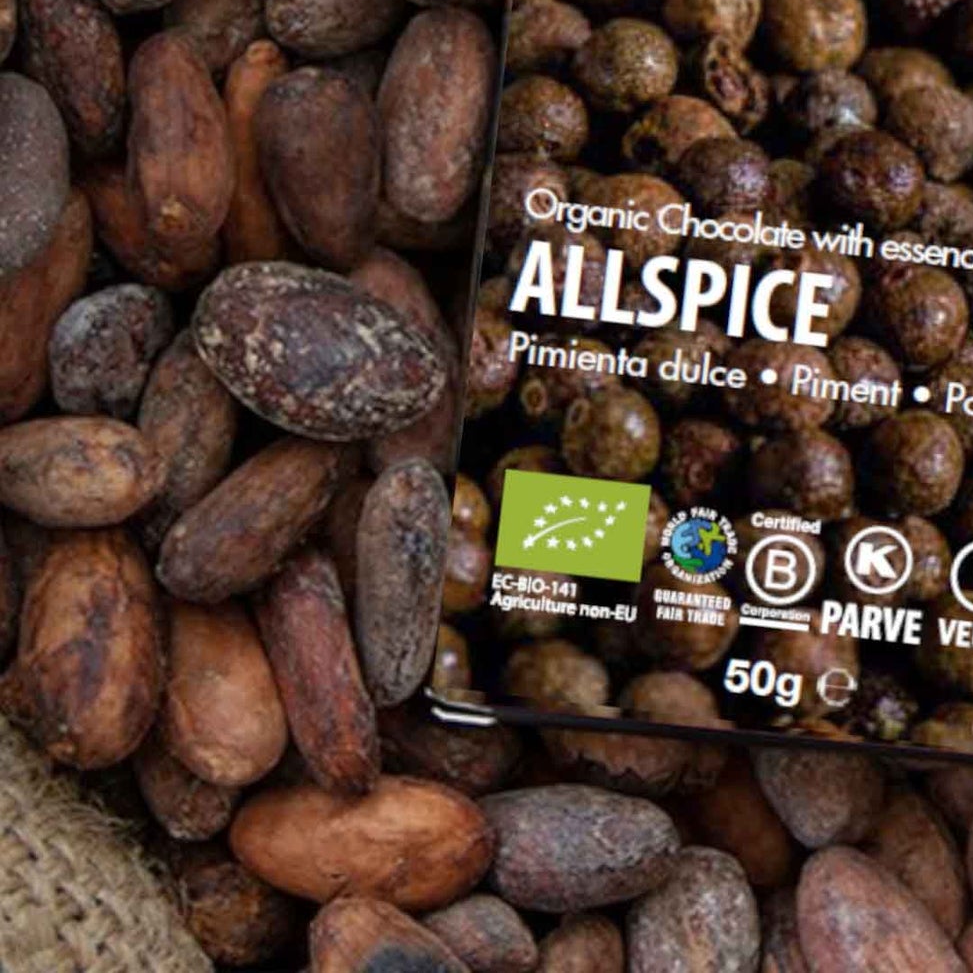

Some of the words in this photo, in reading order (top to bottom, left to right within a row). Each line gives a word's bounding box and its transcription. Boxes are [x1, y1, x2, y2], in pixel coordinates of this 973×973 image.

[525, 187, 649, 233] Organic
[657, 203, 805, 248] Chocolate
[811, 222, 871, 258] with
[509, 239, 834, 347] ALLSPICE
[508, 331, 648, 377] Pimienta
[658, 346, 747, 389] dulce
[791, 366, 902, 407] Piment
[691, 506, 718, 520] FAIR
[718, 515, 739, 555] TRADE
[751, 512, 821, 534] Certified
[765, 549, 798, 591] B
[855, 541, 898, 578] K
[491, 573, 577, 598] EC-BIO-141
[654, 588, 731, 611] GUARANTEED
[490, 590, 577, 616] Agriculture
[579, 604, 637, 622] non-EU
[656, 606, 684, 624] FAIR
[687, 608, 725, 626] TRADE
[740, 604, 810, 622] Corporation
[819, 600, 923, 645] PARVE
[724, 658, 803, 708] 50g
